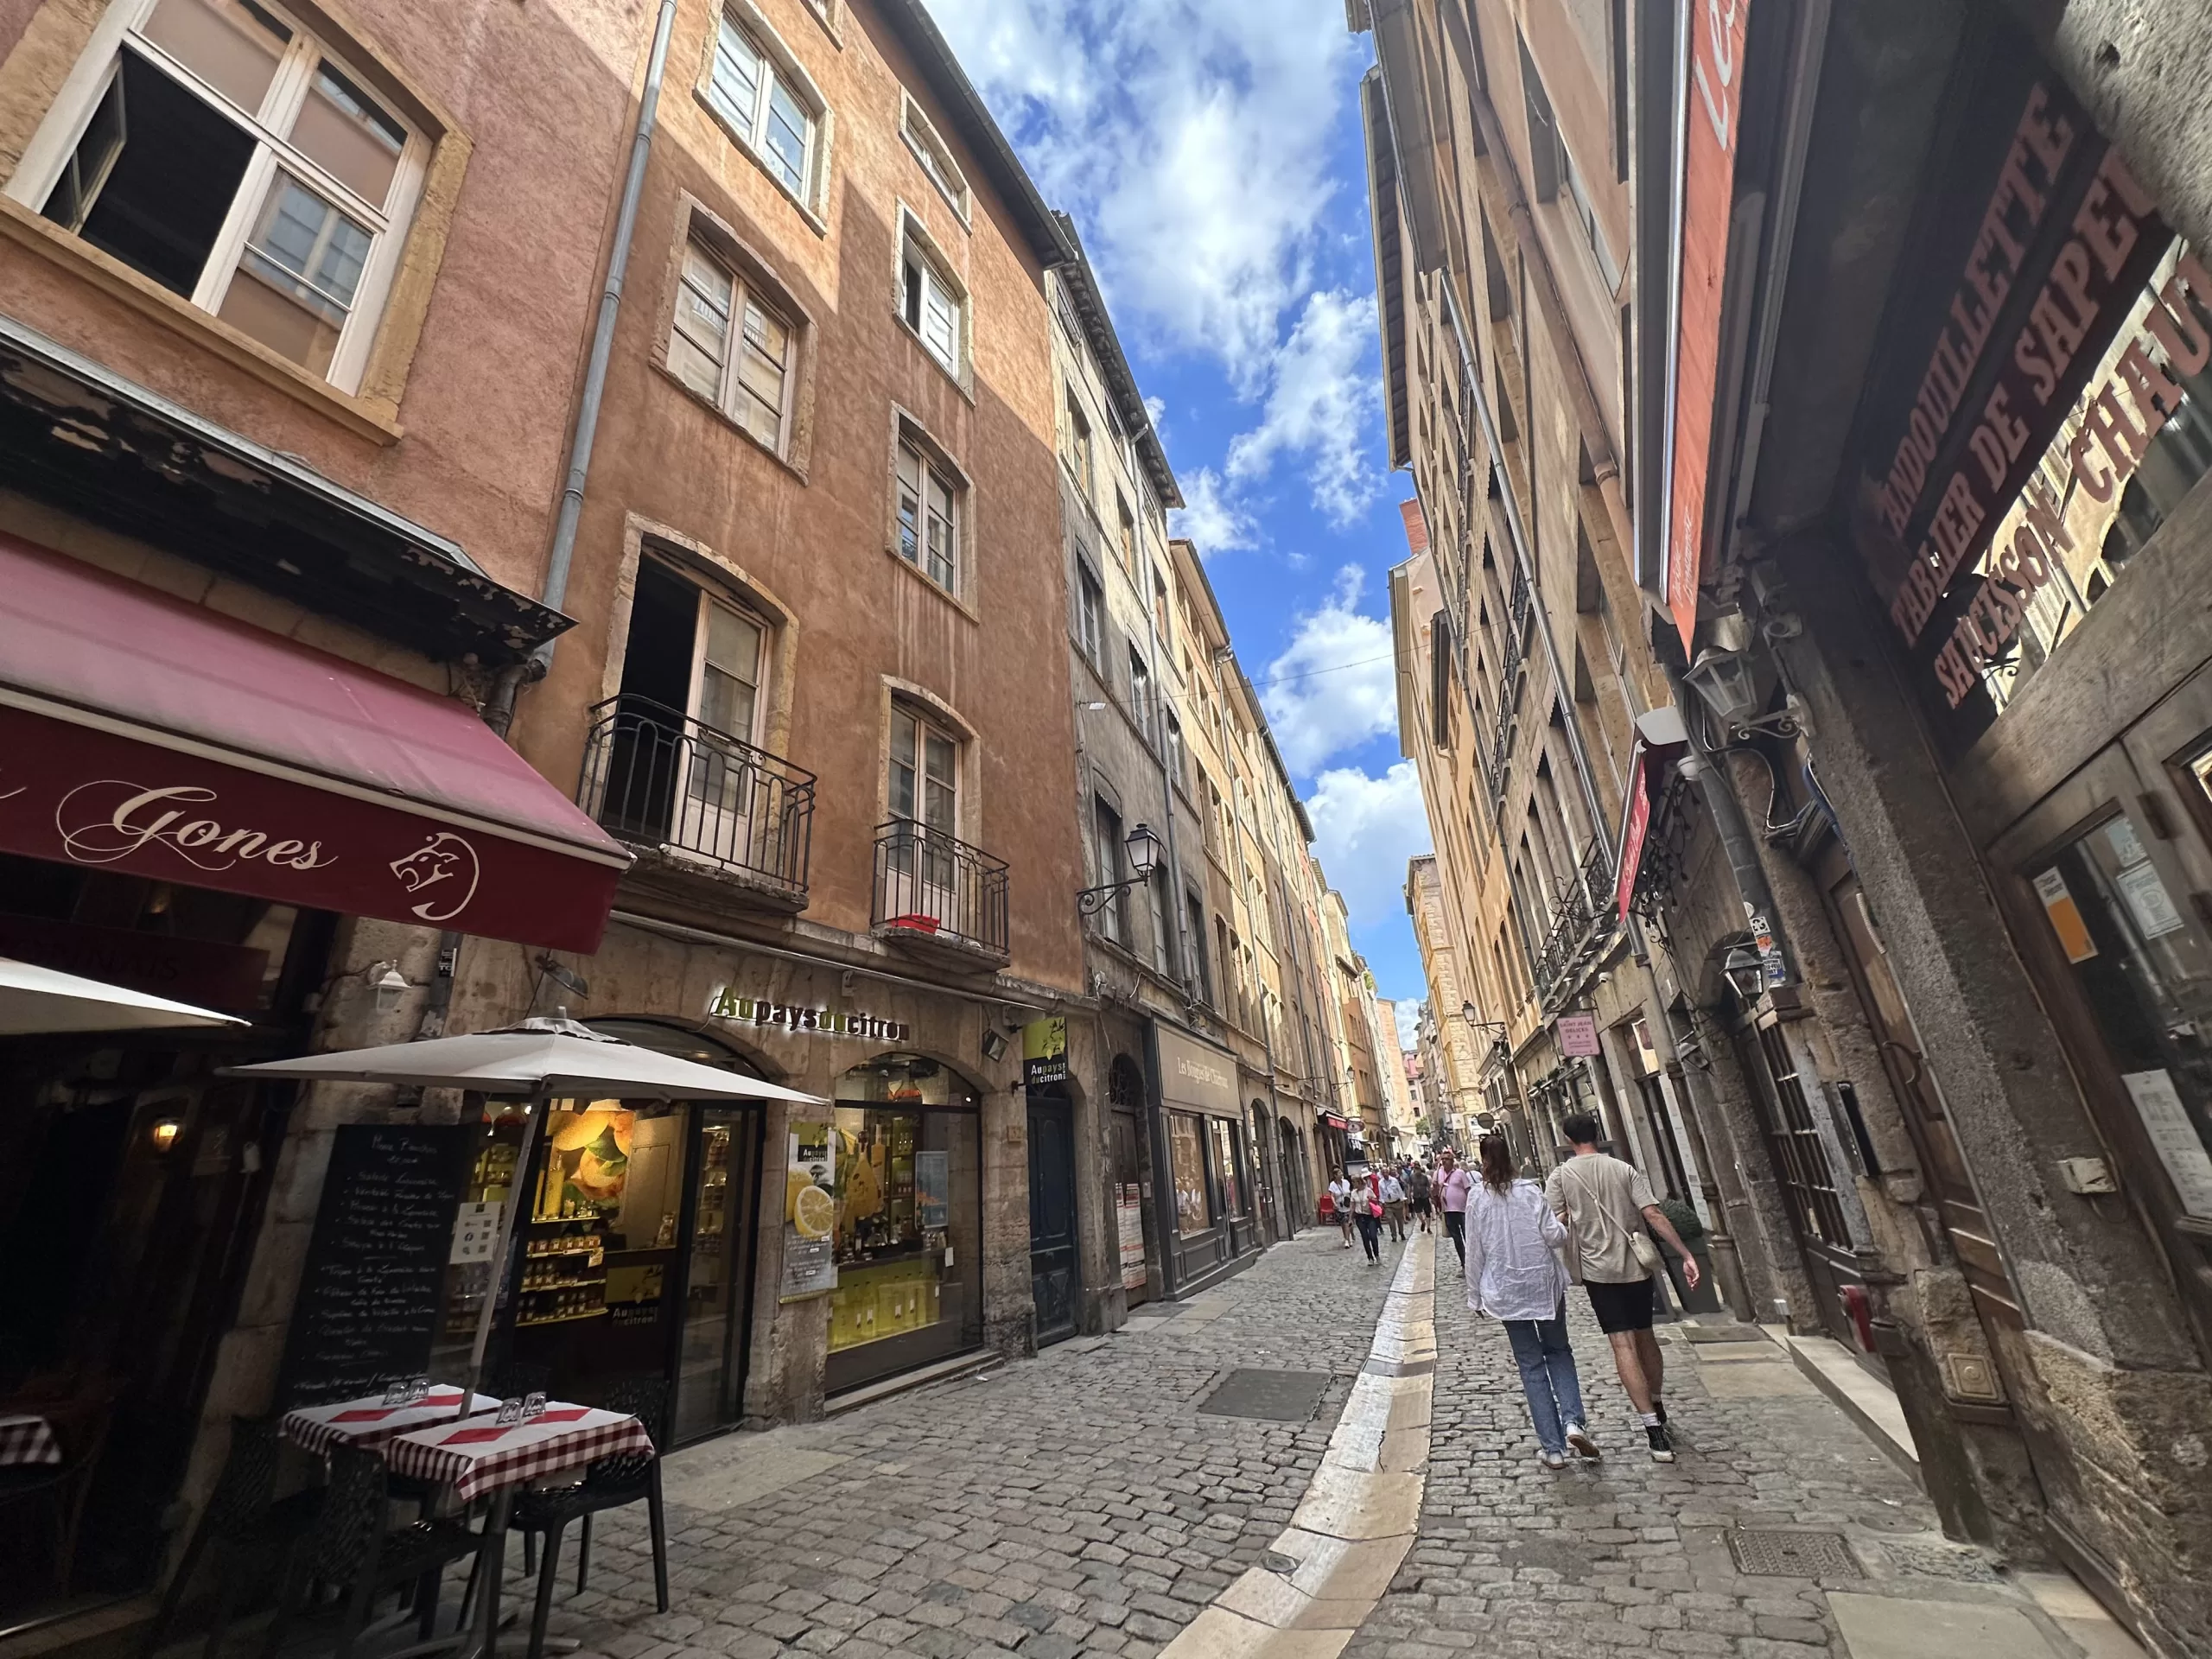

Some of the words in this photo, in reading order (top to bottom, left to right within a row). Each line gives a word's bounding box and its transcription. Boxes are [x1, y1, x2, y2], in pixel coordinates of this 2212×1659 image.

[1879, 80, 2075, 538] ANDOUILLETTE
[1891, 485, 1986, 650] TABLIER
[1969, 384, 2024, 494] DE
[1935, 489, 2076, 709] SAUCISSON
[56, 780, 338, 869] Gones
